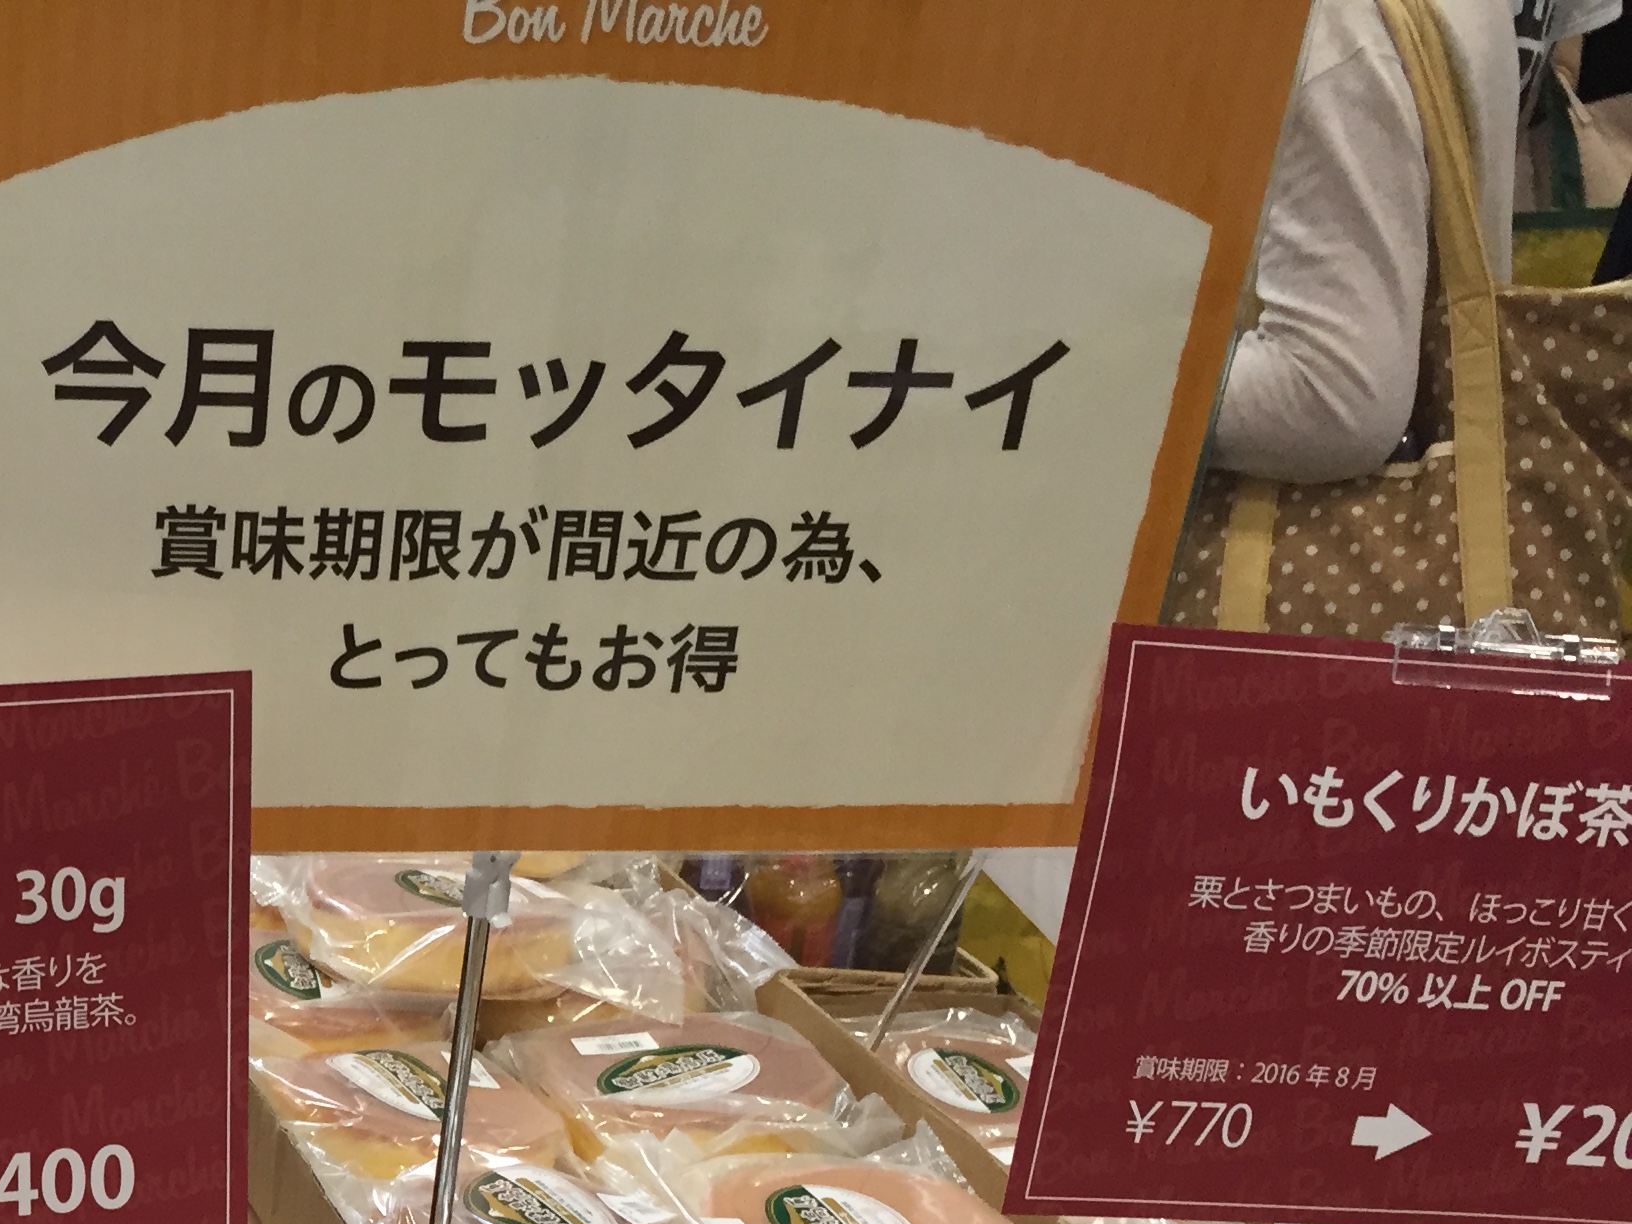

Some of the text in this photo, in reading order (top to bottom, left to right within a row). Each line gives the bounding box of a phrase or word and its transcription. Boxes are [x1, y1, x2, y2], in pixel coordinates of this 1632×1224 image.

[462, 0, 566, 44] Bon
[41, 320, 1072, 451] 今月のモッタイナイ
[151, 505, 886, 588] 賞味期限が間近の為、
[326, 622, 741, 694] とってもお得
[1240, 765, 1632, 849] いもくりかぼ茶
[14, 864, 128, 935] 30g
[1125, 1099, 1254, 1149] ¥770
